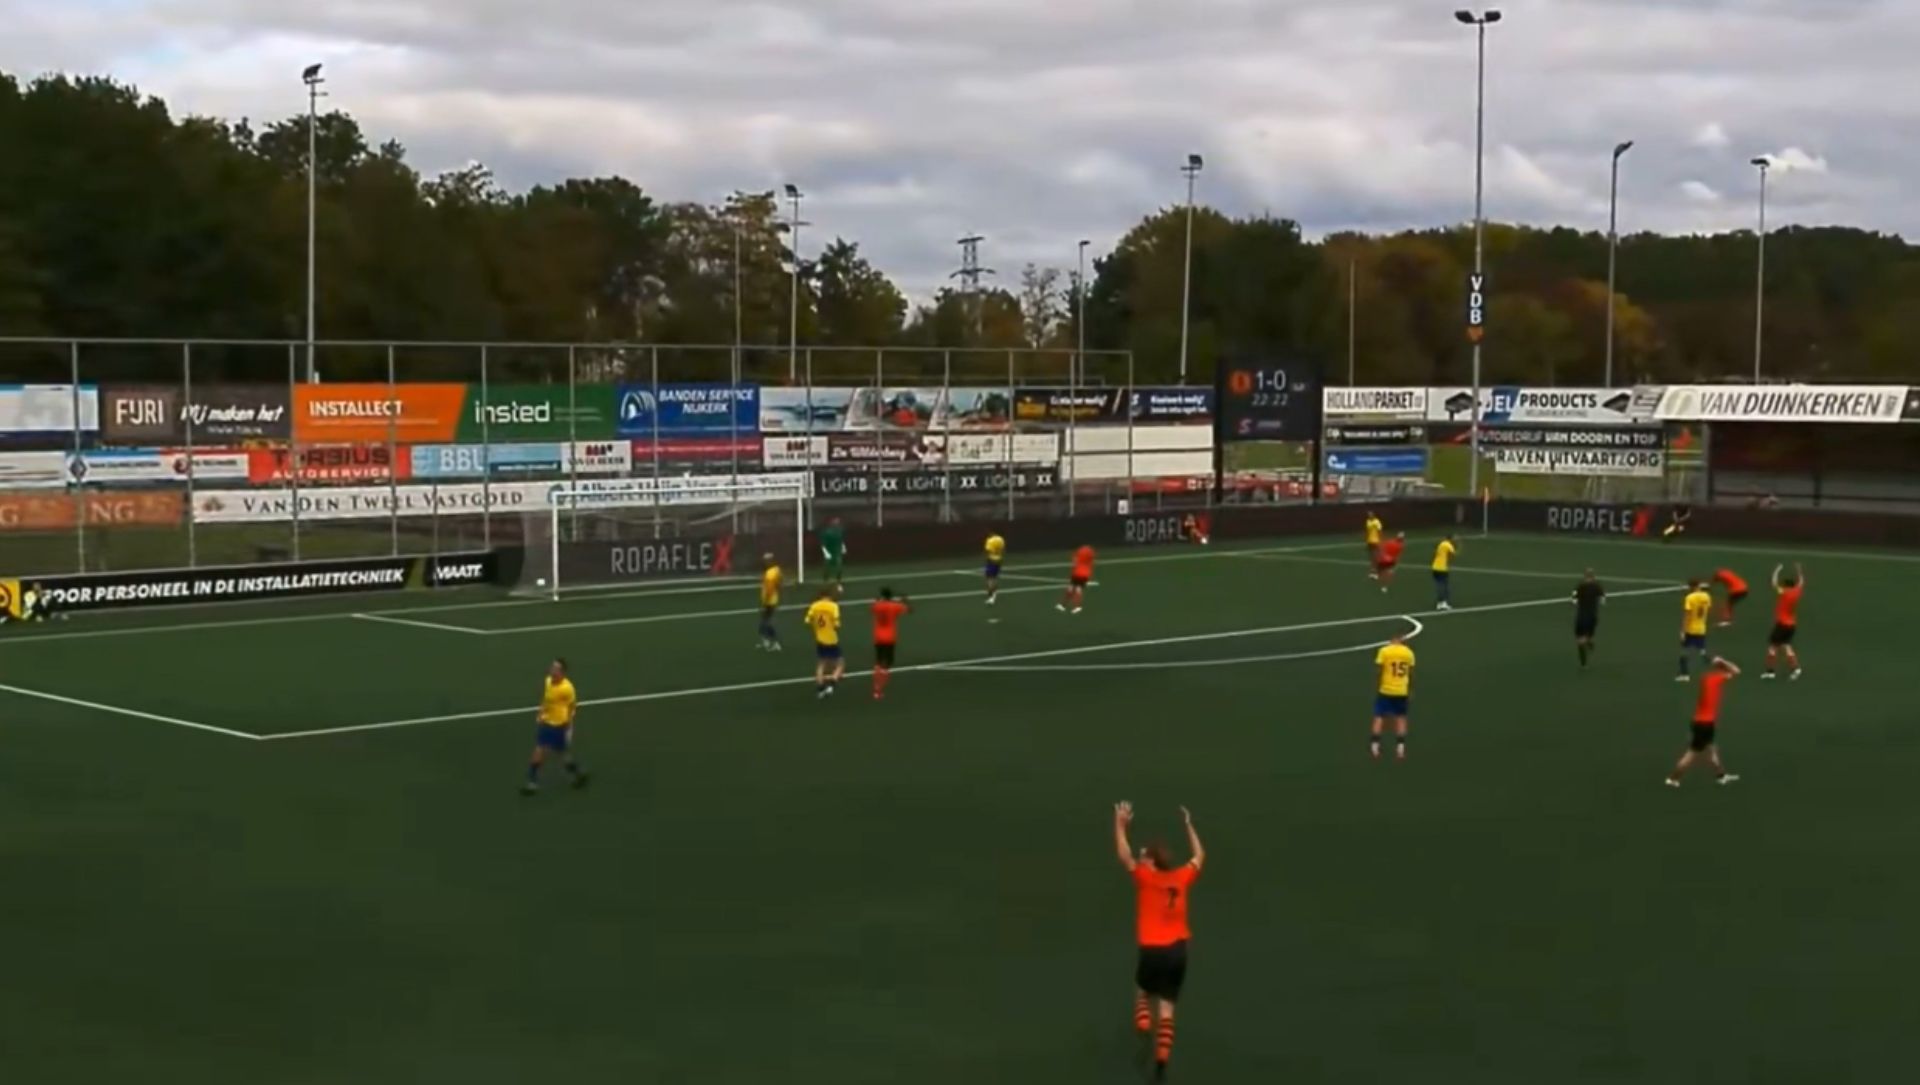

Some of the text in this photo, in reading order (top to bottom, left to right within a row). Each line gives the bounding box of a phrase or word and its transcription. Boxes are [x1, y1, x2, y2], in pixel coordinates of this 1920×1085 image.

[1470, 275, 1482, 324] VDB
[1256, 369, 1287, 390] 1-0
[659, 389, 707, 402] BANDEN
[1519, 393, 1597, 409] PRODUCTS
[1701, 392, 1742, 414] VAN
[1743, 393, 1882, 417] DUINKERKEN
[309, 401, 403, 417] INSTALLECT
[475, 400, 549, 423] insted
[1570, 430, 1612, 444] DOORN
[1615, 431, 1631, 445] EN
[1633, 431, 1657, 445] TOP
[1497, 450, 1545, 464] RAVEN
[611, 533, 735, 575] ROPAFLEX
[95, 580, 190, 601] PERSONEEL
[193, 578, 212, 595] IN
[215, 577, 235, 594] DE
[237, 568, 405, 593] INSTALLATIETECHNIEK
[1391, 661, 1407, 678] 15
